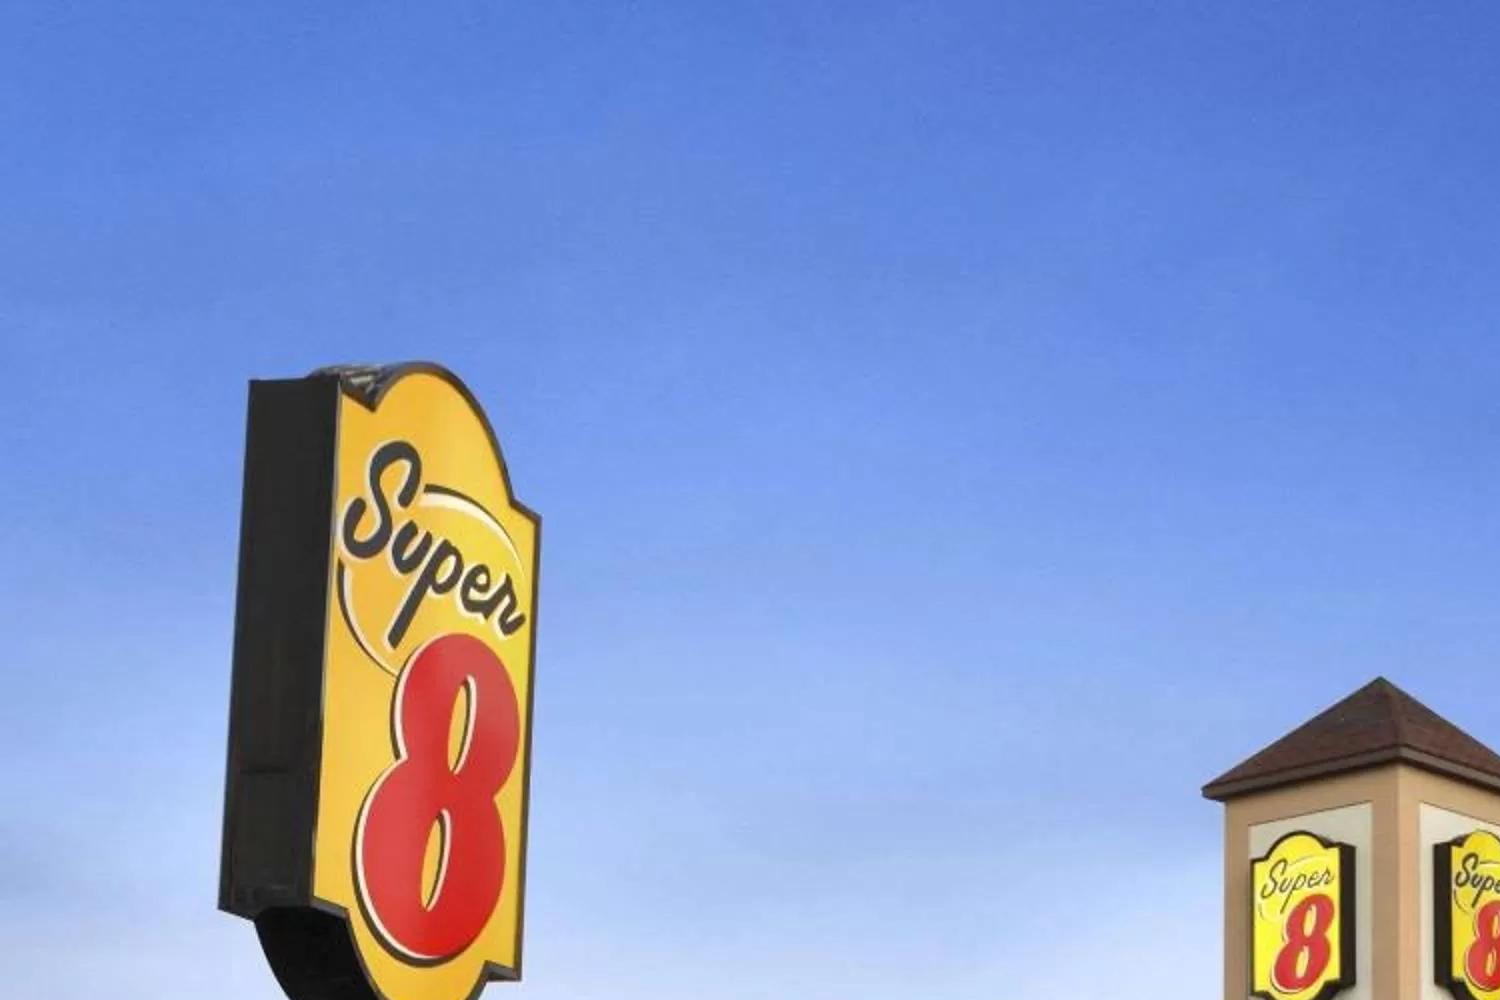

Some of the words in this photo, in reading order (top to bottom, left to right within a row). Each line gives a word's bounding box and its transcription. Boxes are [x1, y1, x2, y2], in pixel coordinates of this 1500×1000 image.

[342, 439, 526, 651] Super
[352, 631, 521, 968] 8
[1260, 858, 1334, 914] Super
[1271, 893, 1335, 992] 8
